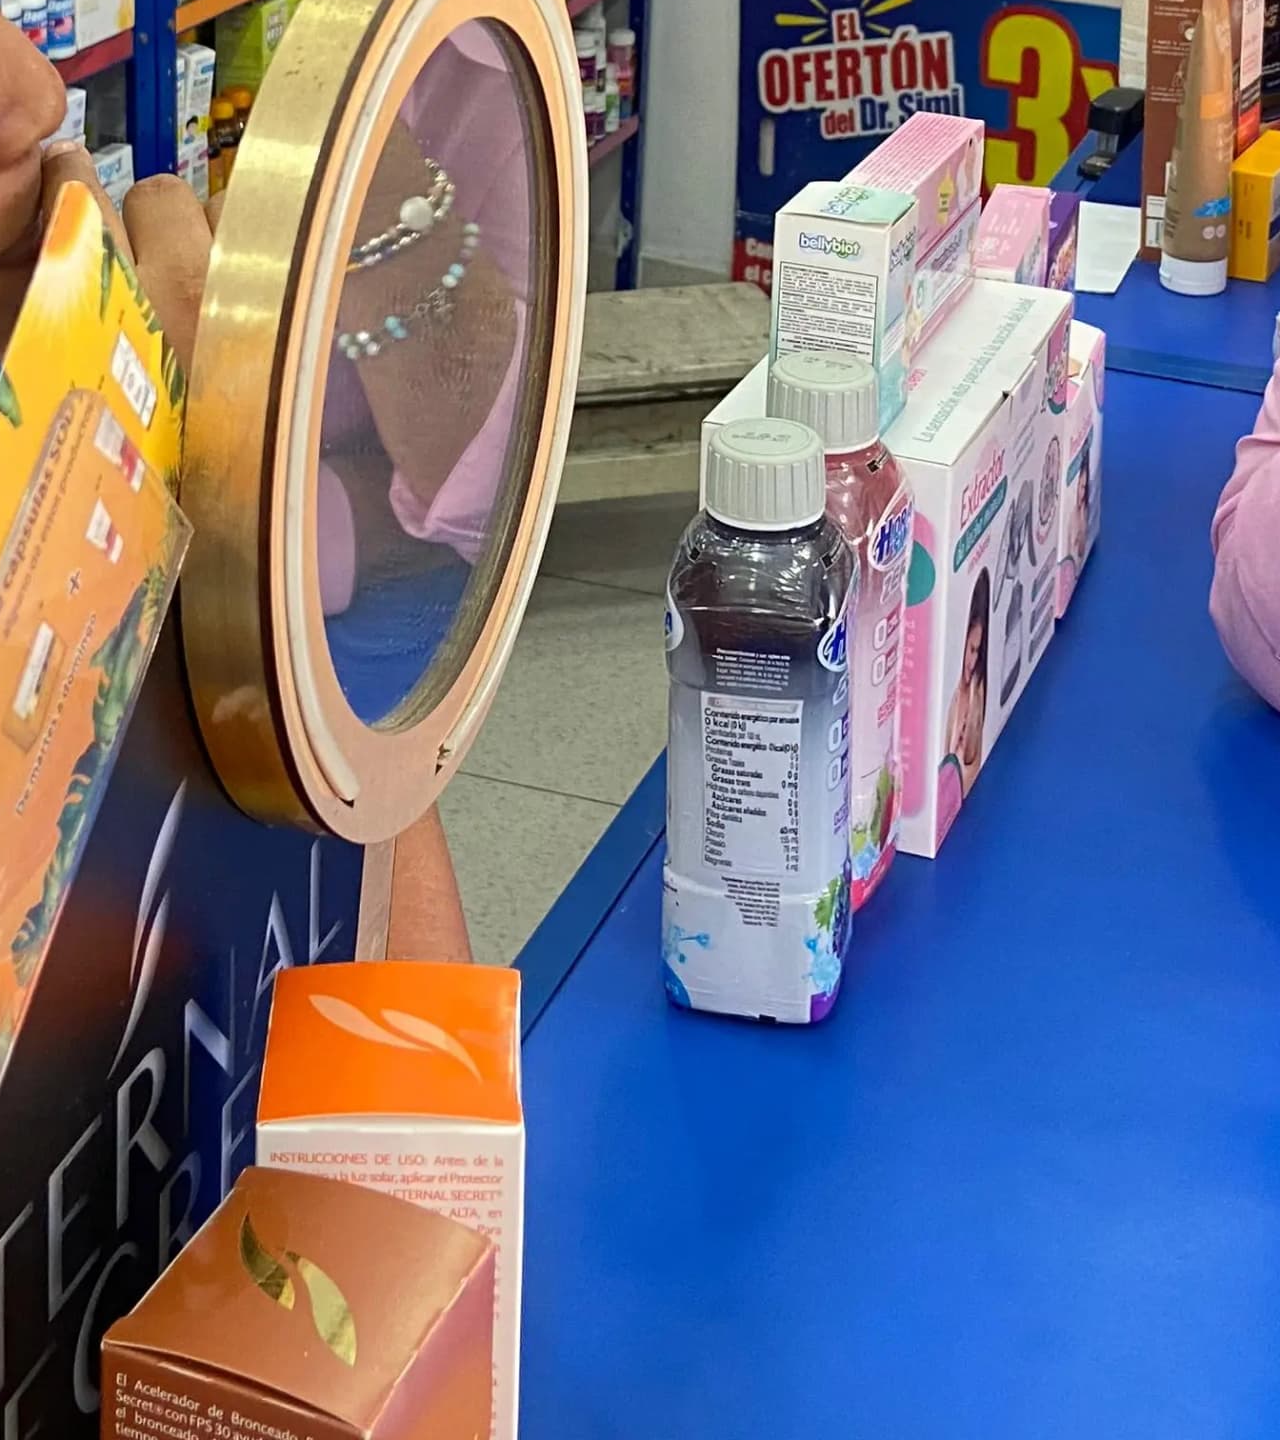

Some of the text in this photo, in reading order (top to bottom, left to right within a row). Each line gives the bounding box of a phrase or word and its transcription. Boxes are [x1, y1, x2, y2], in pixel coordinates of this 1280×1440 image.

[836, 11, 860, 42] EL
[763, 31, 950, 107] OFERTÓN
[824, 107, 855, 135] del
[860, 96, 894, 132] Dr.
[960, 448, 1006, 530] Extractor
[29, 720, 57, 786] martes
[60, 612, 99, 703] domingo
[704, 707, 740, 720] Contenido
[705, 735, 740, 748] Contenido
[711, 763, 734, 776] Grasas
[711, 773, 734, 785] Grasas
[712, 791, 742, 805] Azúcares
[712, 801, 742, 814] Azúcares
[706, 817, 725, 830] Sodio
[270, 1152, 368, 1165] INSTRUCCIONES
[374, 1153, 391, 1165] DE
[434, 1155, 467, 1167] Antes
[473, 1155, 489, 1167] de
[494, 1156, 503, 1167] la
[351, 1172, 367, 1183] luz
[370, 1172, 398, 1185] solar,
[400, 1173, 435, 1187] aplicar
[438, 1173, 447, 1184] el
[450, 1174, 503, 1185] Protector
[393, 1190, 450, 1201] ETERNAL
[449, 1209, 502, 1220] ALTA, en
[477, 1225, 502, 1236] Para
[115, 1372, 128, 1388] El
[134, 1379, 200, 1413] Acelerador
[208, 1404, 223, 1420] de
[231, 1411, 299, 1440] Bronceado
[115, 1406, 199, 1440] el bronceado
[165, 1408, 188, 1424] con
[189, 1414, 214, 1433] FPS
[215, 1424, 232, 1439] 30
